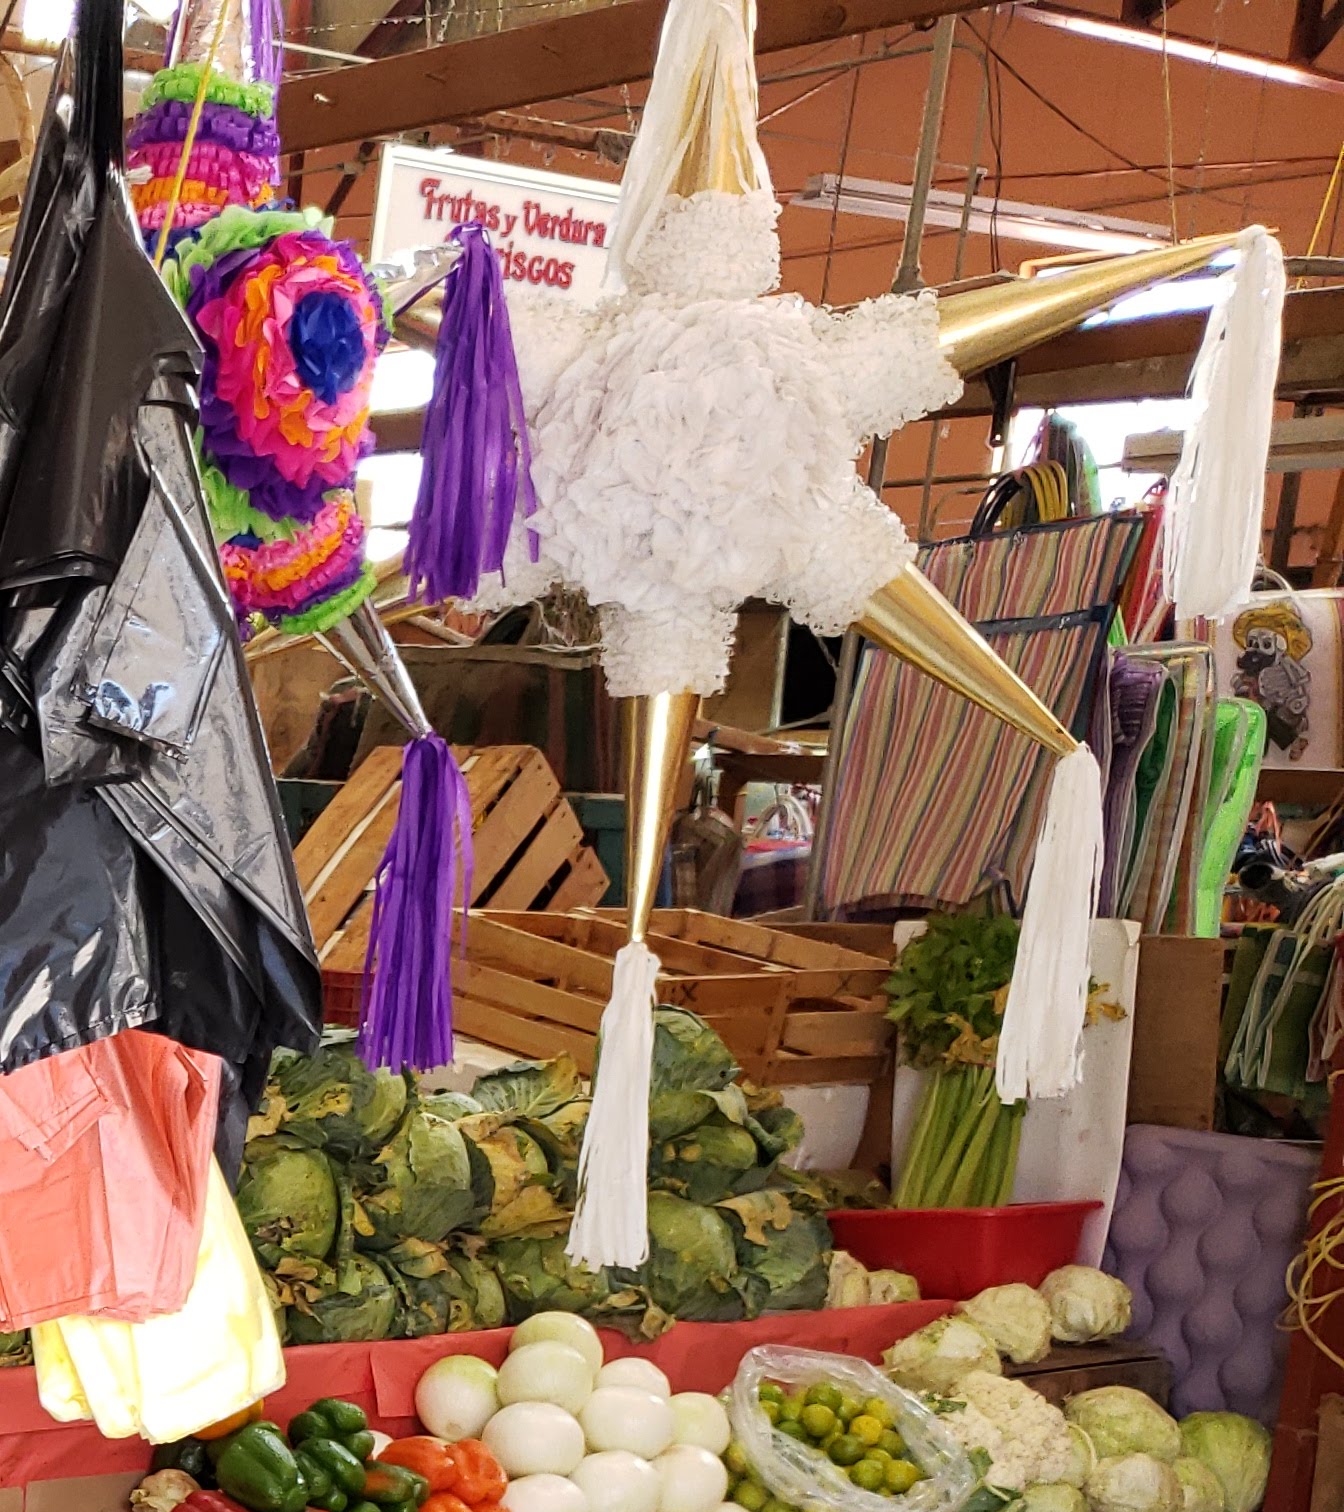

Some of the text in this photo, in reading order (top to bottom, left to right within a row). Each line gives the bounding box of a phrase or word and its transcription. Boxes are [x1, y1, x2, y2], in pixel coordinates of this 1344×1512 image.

[419, 177, 608, 248] Frutas y Verdura
